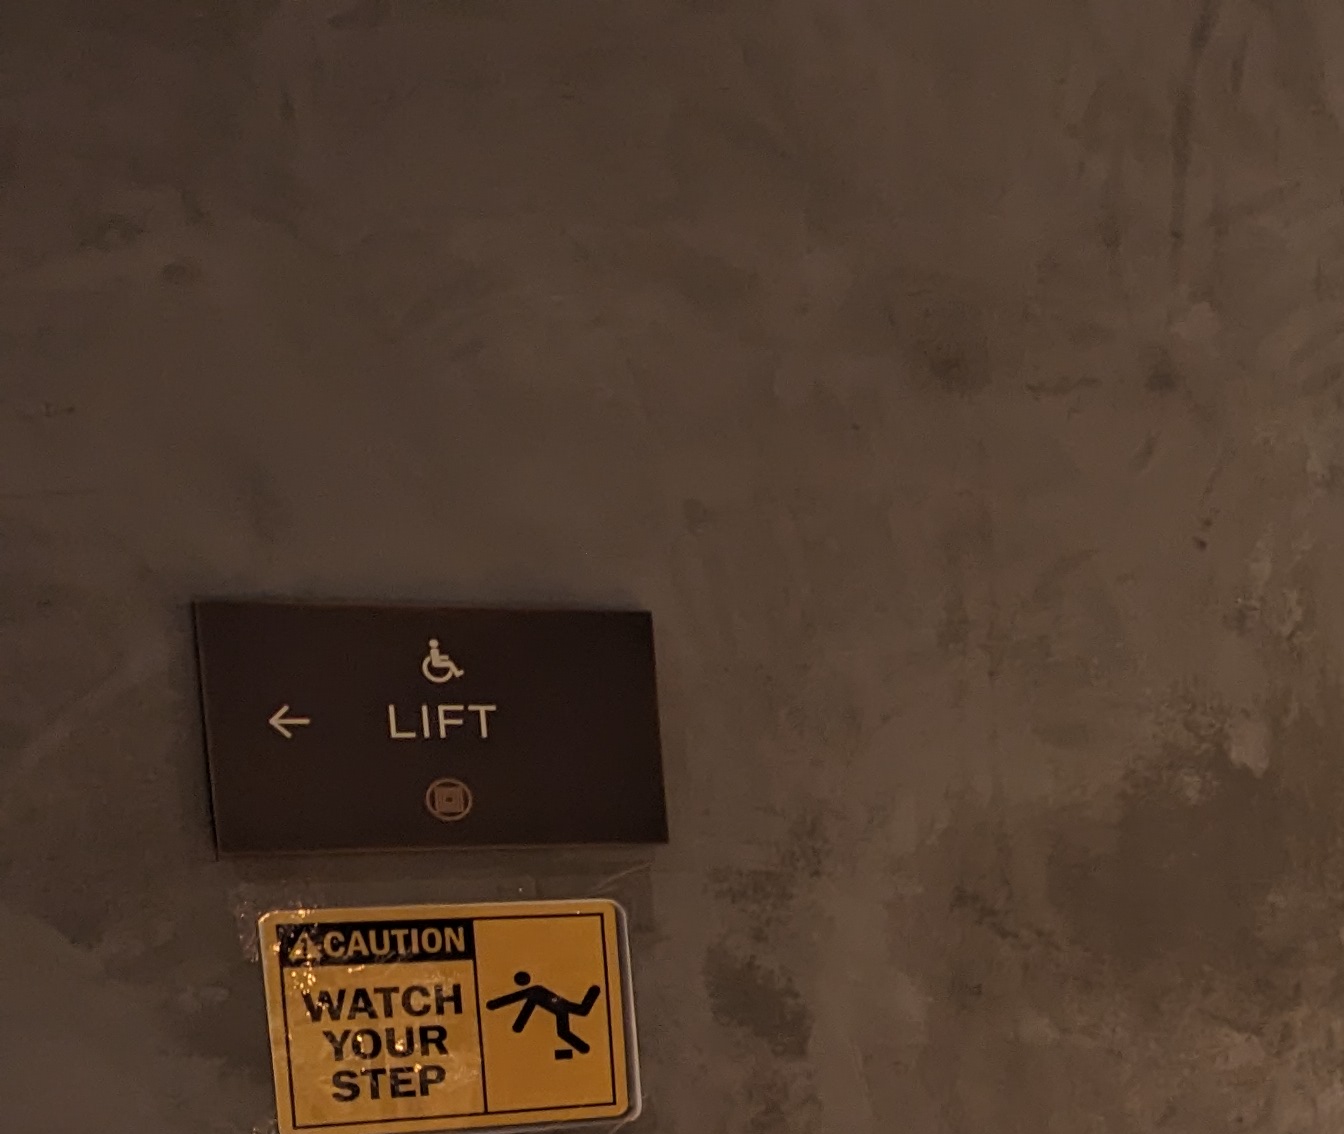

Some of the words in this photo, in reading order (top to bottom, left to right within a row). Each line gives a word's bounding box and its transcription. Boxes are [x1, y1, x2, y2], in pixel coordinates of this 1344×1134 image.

[388, 704, 498, 740] LIFT
[323, 926, 467, 957] CAUTION
[302, 982, 464, 1024] WATCH
[322, 1025, 449, 1062] YOUR
[331, 1064, 447, 1102] STEP
